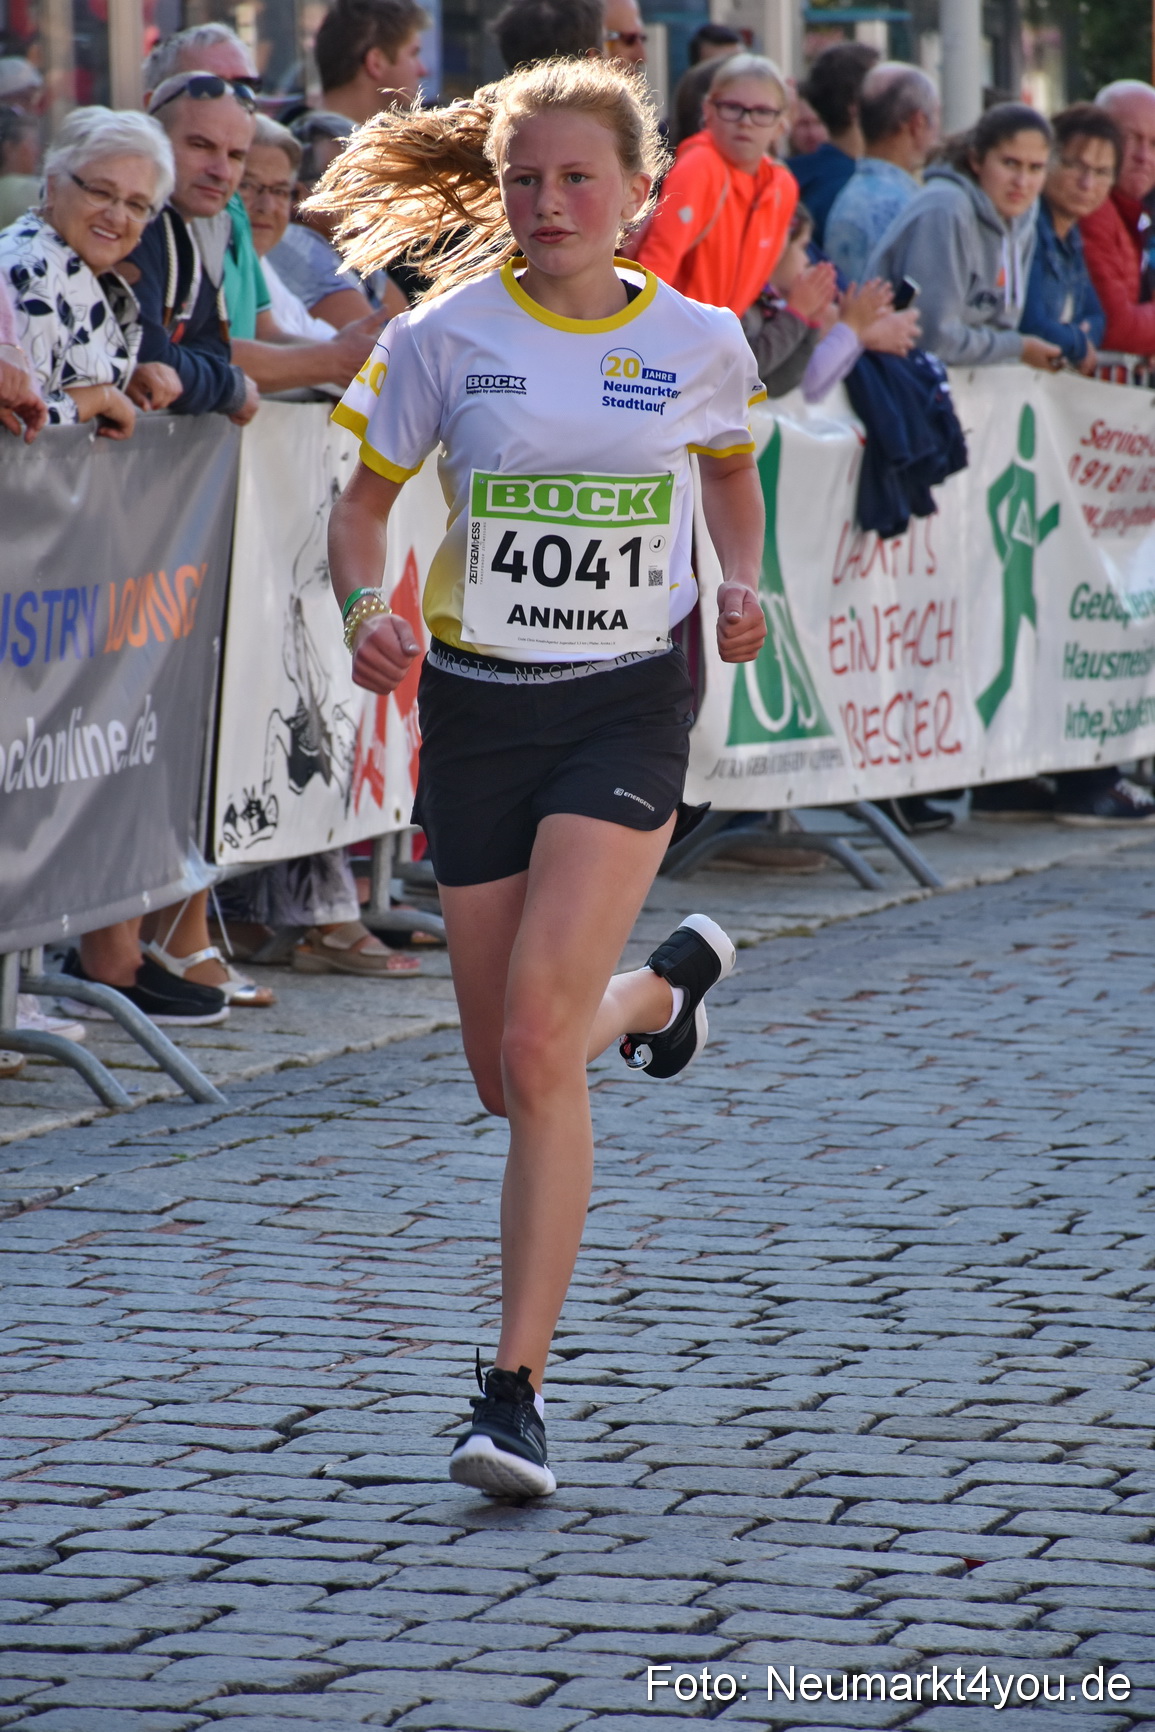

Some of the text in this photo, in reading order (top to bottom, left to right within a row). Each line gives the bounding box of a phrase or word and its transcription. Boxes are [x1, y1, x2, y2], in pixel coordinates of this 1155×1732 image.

[466, 374, 527, 390] BOCK
[605, 355, 673, 382] 20 JAHRE
[603, 379, 682, 399] Neumarkter
[602, 395, 666, 416] Stadtlauf
[487, 481, 659, 520] BOCK
[491, 530, 642, 590] 4041
[506, 603, 629, 631] ANNIKA
